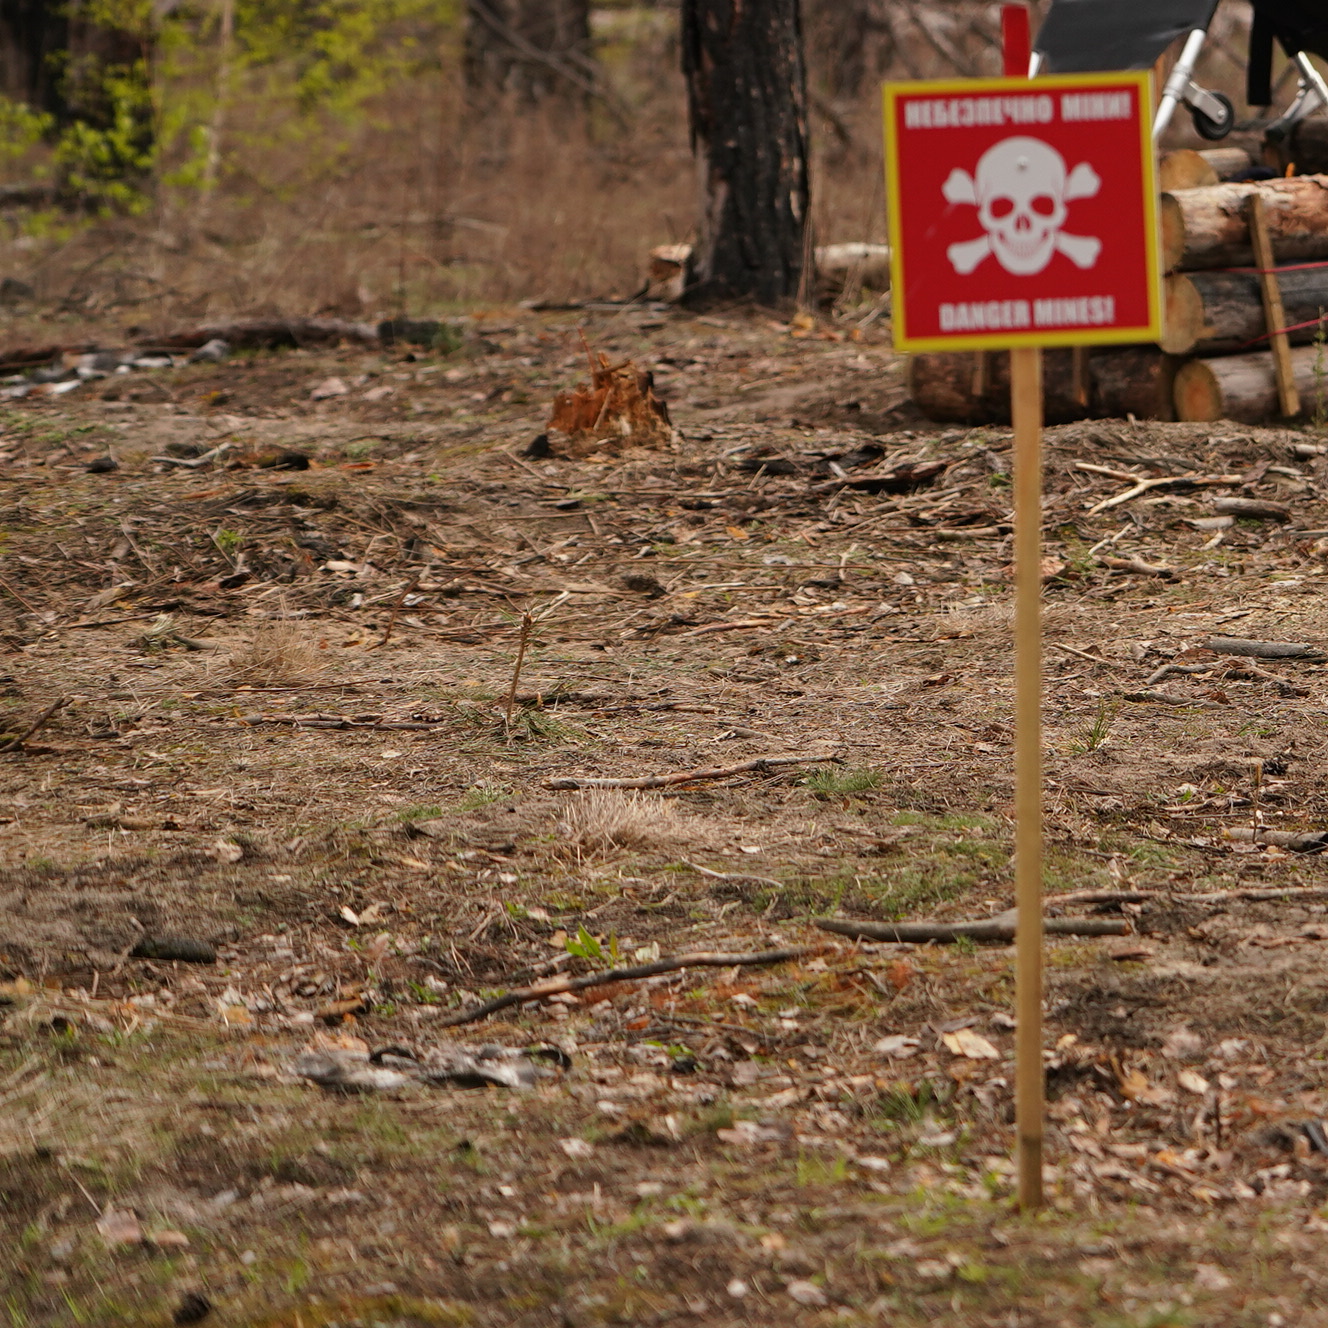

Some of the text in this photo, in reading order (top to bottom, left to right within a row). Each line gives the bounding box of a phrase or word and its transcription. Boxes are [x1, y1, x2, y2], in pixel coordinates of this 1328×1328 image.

[905, 95, 1053, 129] НЕБЕЗПЕЧНО
[939, 295, 1114, 332] DANGER MINES!
